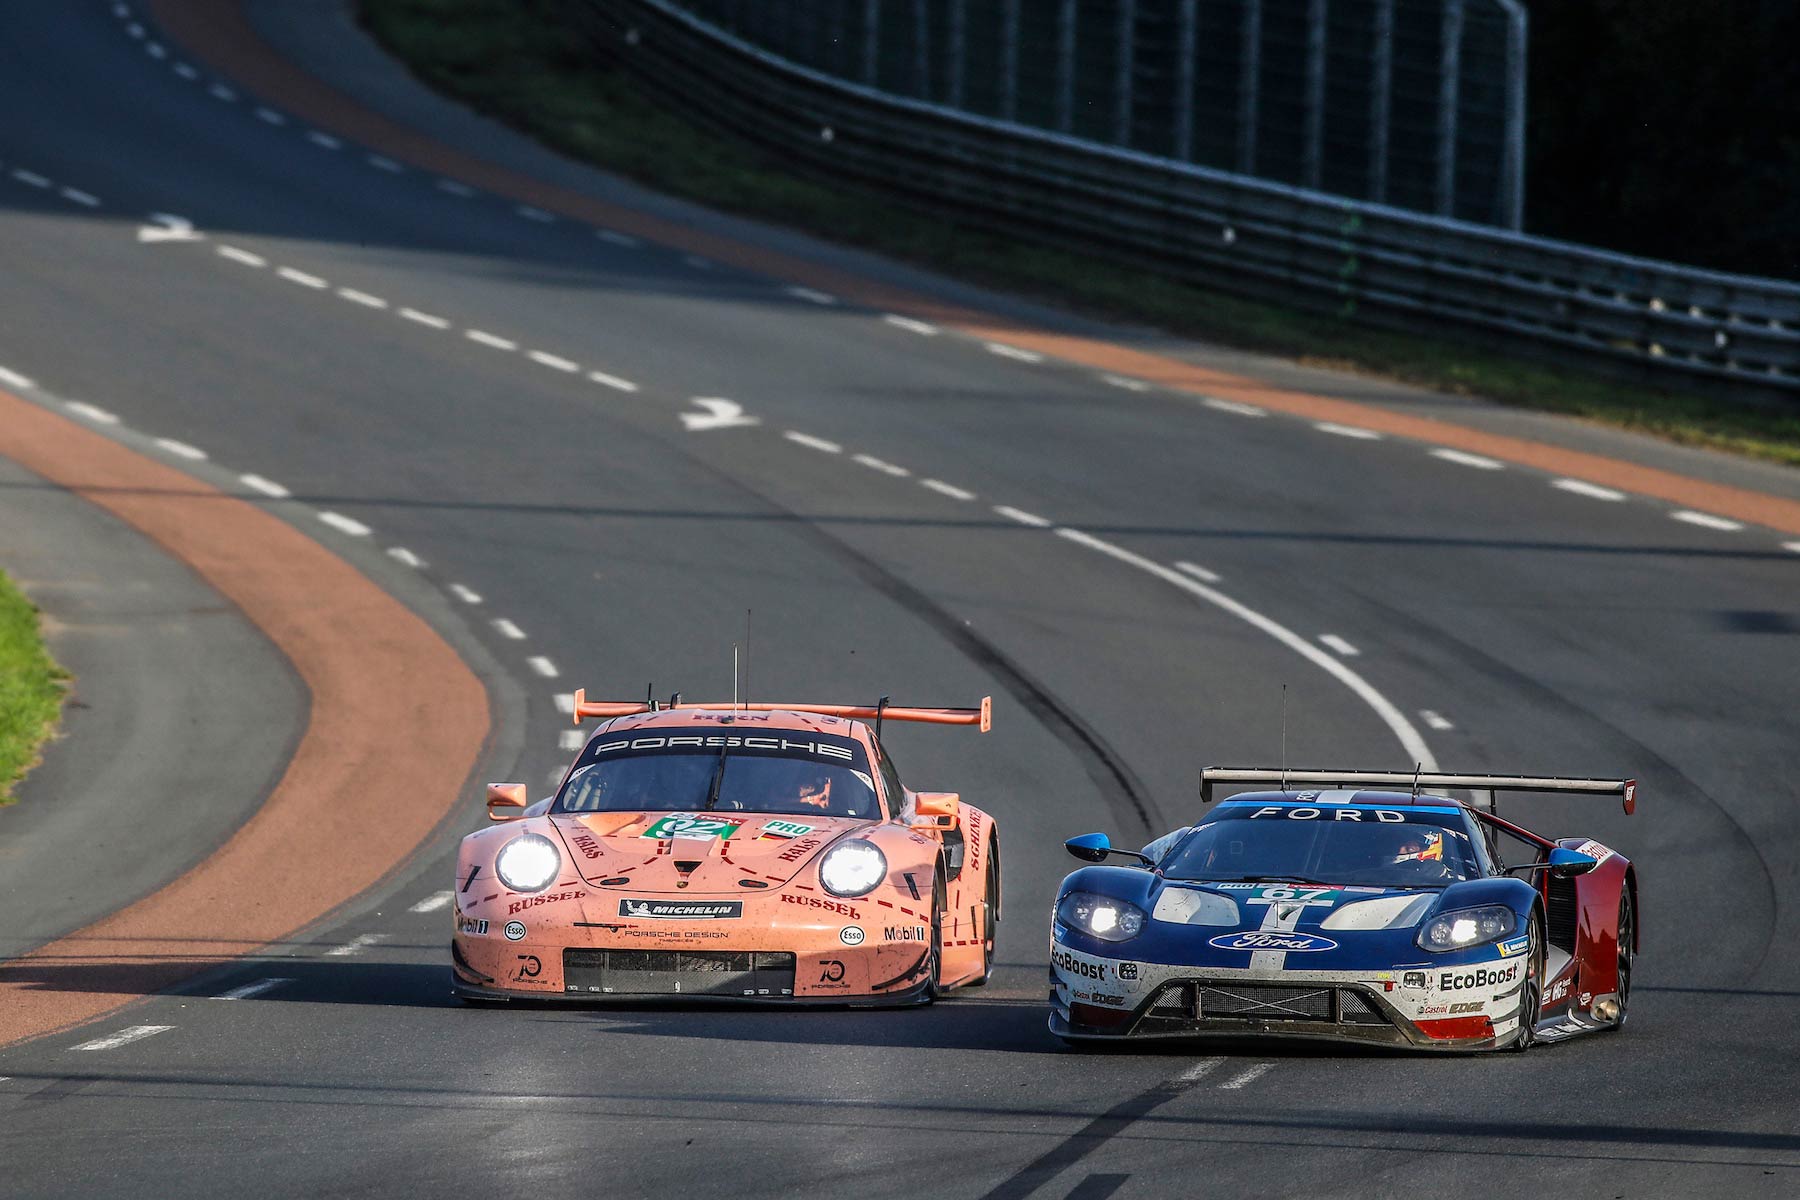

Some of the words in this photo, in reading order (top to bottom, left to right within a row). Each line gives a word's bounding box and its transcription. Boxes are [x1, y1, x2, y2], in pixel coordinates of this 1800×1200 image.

[595, 736, 852, 760] PORSCHE
[1250, 807, 1405, 823] FORD
[656, 819, 726, 838] 92
[765, 821, 811, 834] PRO
[1261, 888, 1331, 899] 67
[652, 906, 732, 914] MICHELIN
[625, 930, 680, 938] PORSCHE
[884, 926, 916, 940] Mobil
[1232, 932, 1314, 949] Ford
[1440, 962, 1519, 991] EcoBoost
[1425, 1005, 1447, 1014] Castrol
[1449, 1001, 1485, 1014] EDGE
